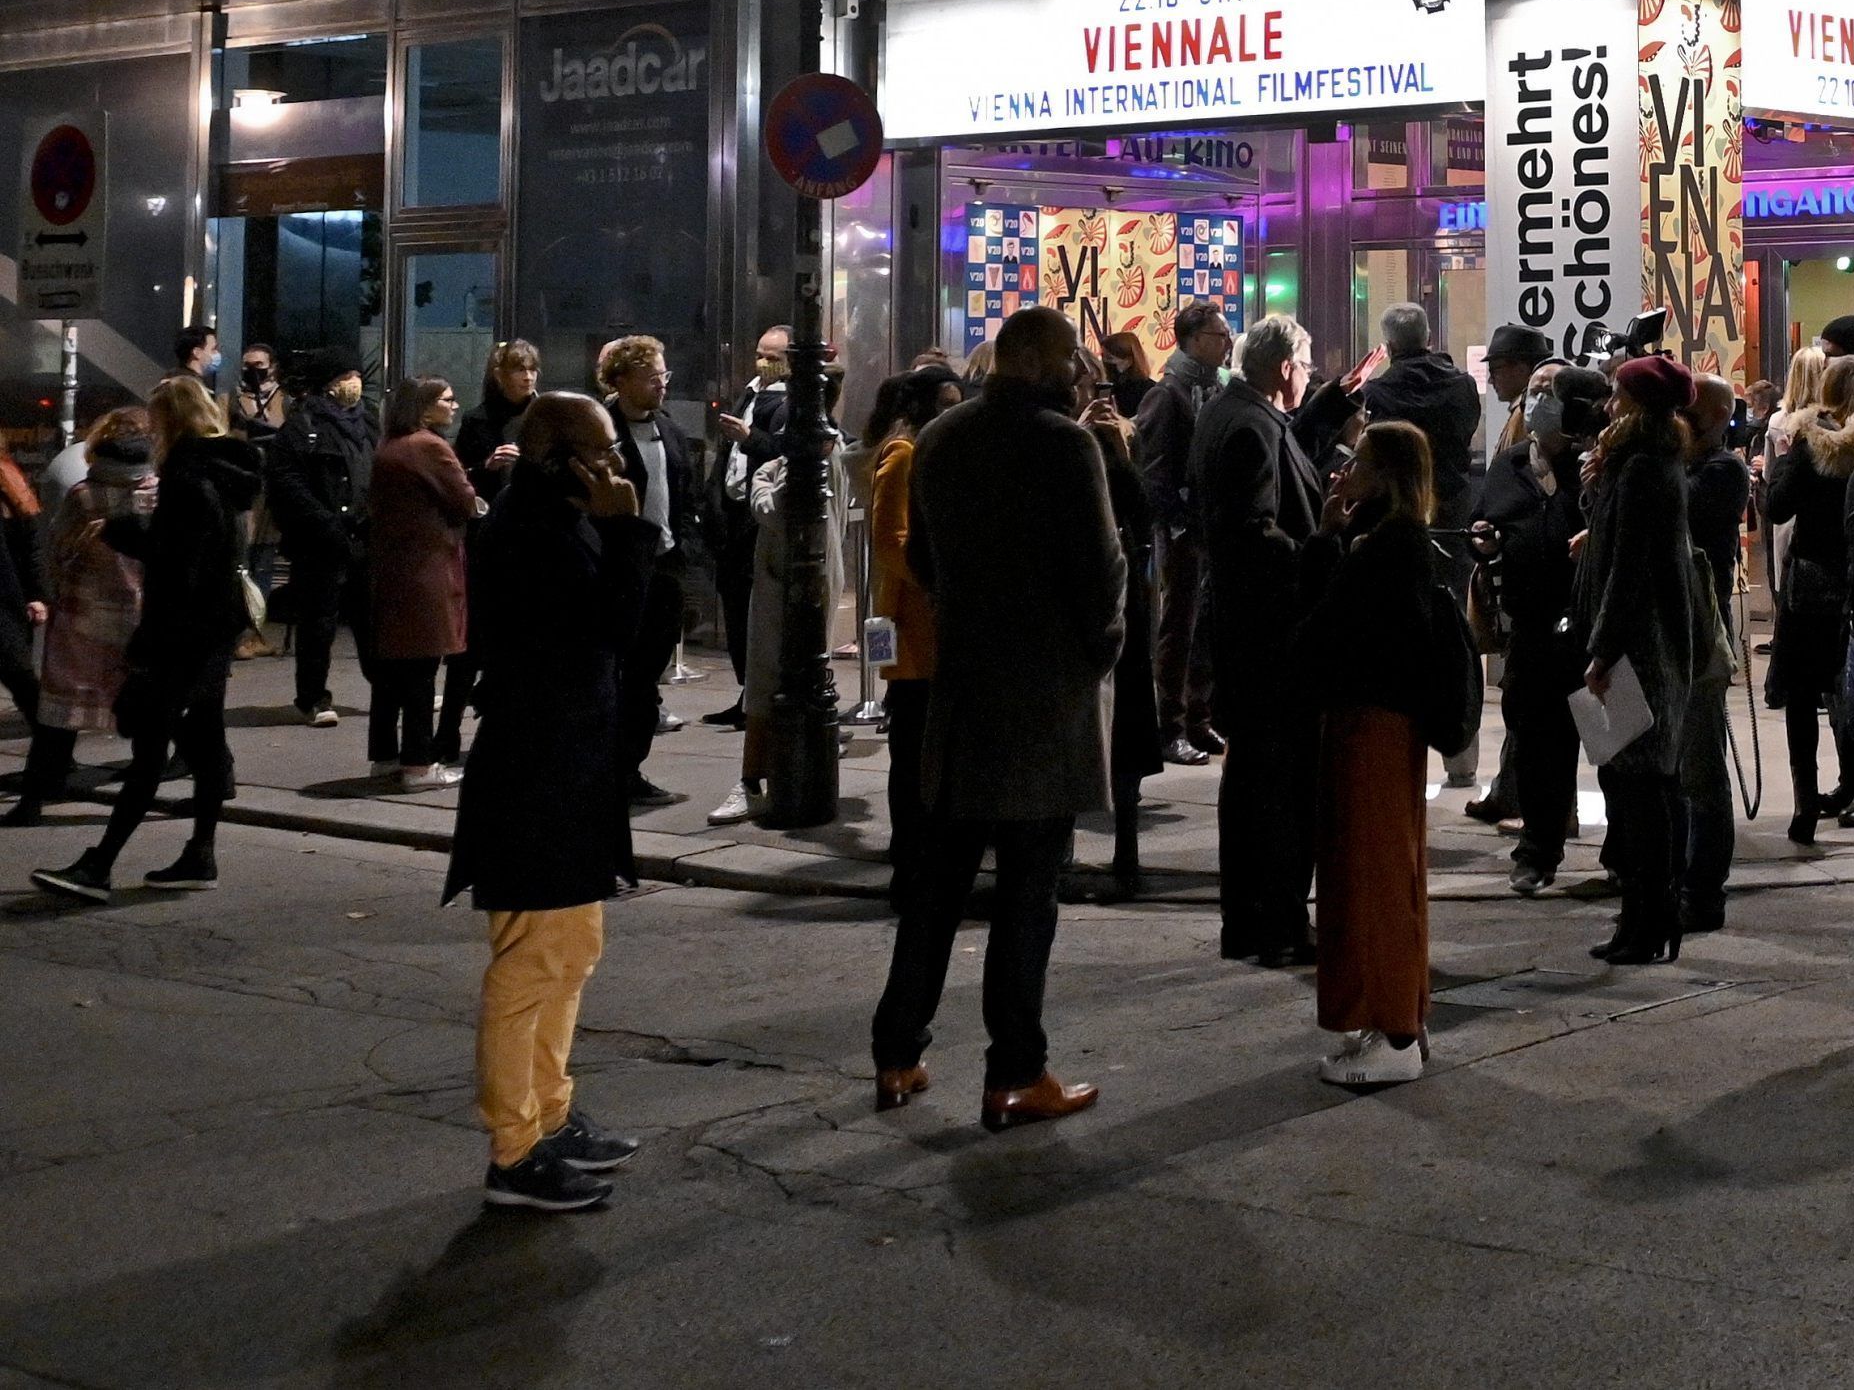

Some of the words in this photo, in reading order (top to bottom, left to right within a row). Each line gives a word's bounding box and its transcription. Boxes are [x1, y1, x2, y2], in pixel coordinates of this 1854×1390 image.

[539, 41, 706, 103] Jaadcar
[1084, 10, 1283, 74] VIENNALE
[969, 91, 1052, 122] VIENNA
[1065, 78, 1241, 116] INTERNATIONAL
[1258, 62, 1434, 103] FILMFESTIVAL
[1184, 137, 1254, 169] KINO
[1648, 74, 1704, 173] VI
[970, 217, 985, 228] V20
[1004, 219, 1018, 229] V20
[1506, 50, 1554, 356] ermehrt
[1650, 163, 1718, 254] EN
[969, 272, 984, 282] V20
[986, 245, 1002, 256] V20
[1021, 246, 1035, 256] V20
[1655, 251, 1738, 342] NA
